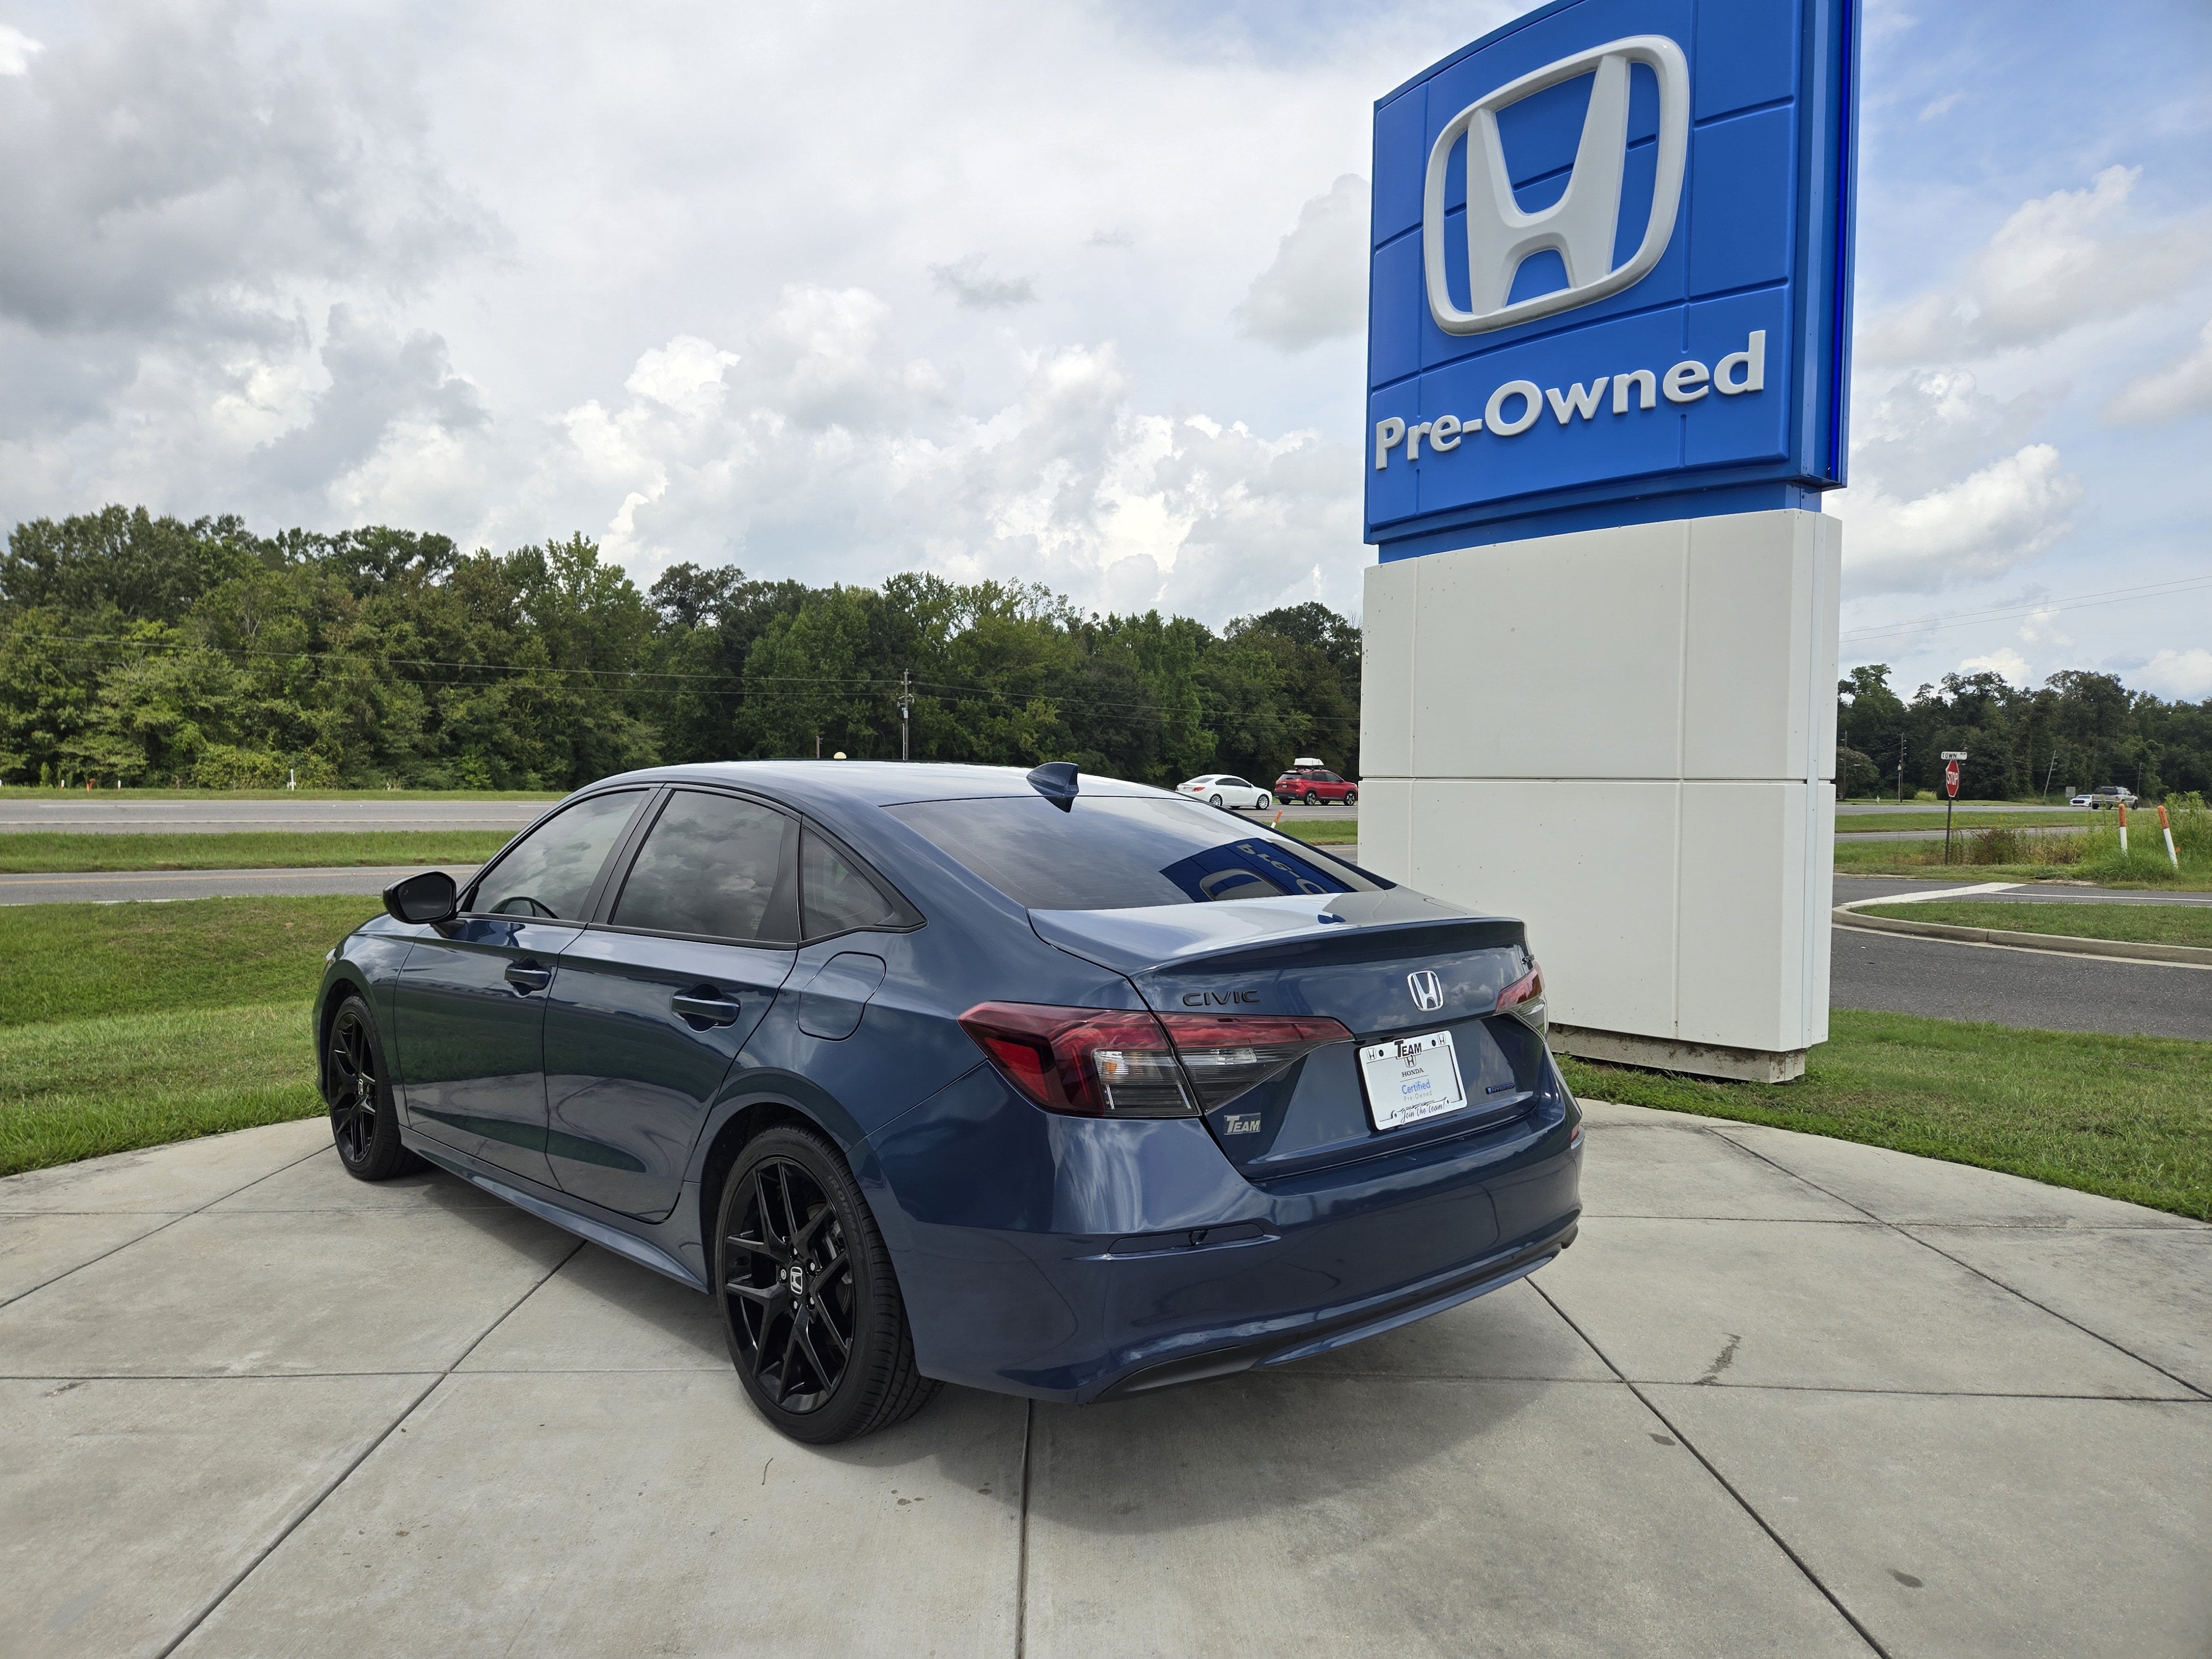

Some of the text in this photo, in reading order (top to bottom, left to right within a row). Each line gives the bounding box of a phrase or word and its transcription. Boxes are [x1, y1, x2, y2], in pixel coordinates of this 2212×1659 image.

[1375, 330, 1766, 470] Pre-Owned
[1947, 771, 1958, 785] STOP
[1182, 989, 1260, 1006] CIVIC
[1394, 1040, 1422, 1058] TEAM
[1401, 1068, 1424, 1077] HONDA
[1402, 1079, 1431, 1094] Certified
[1404, 1089, 1433, 1102] Pre-Owned
[1401, 1109, 1415, 1124] Join
[1225, 1115, 1261, 1134] TEAM
